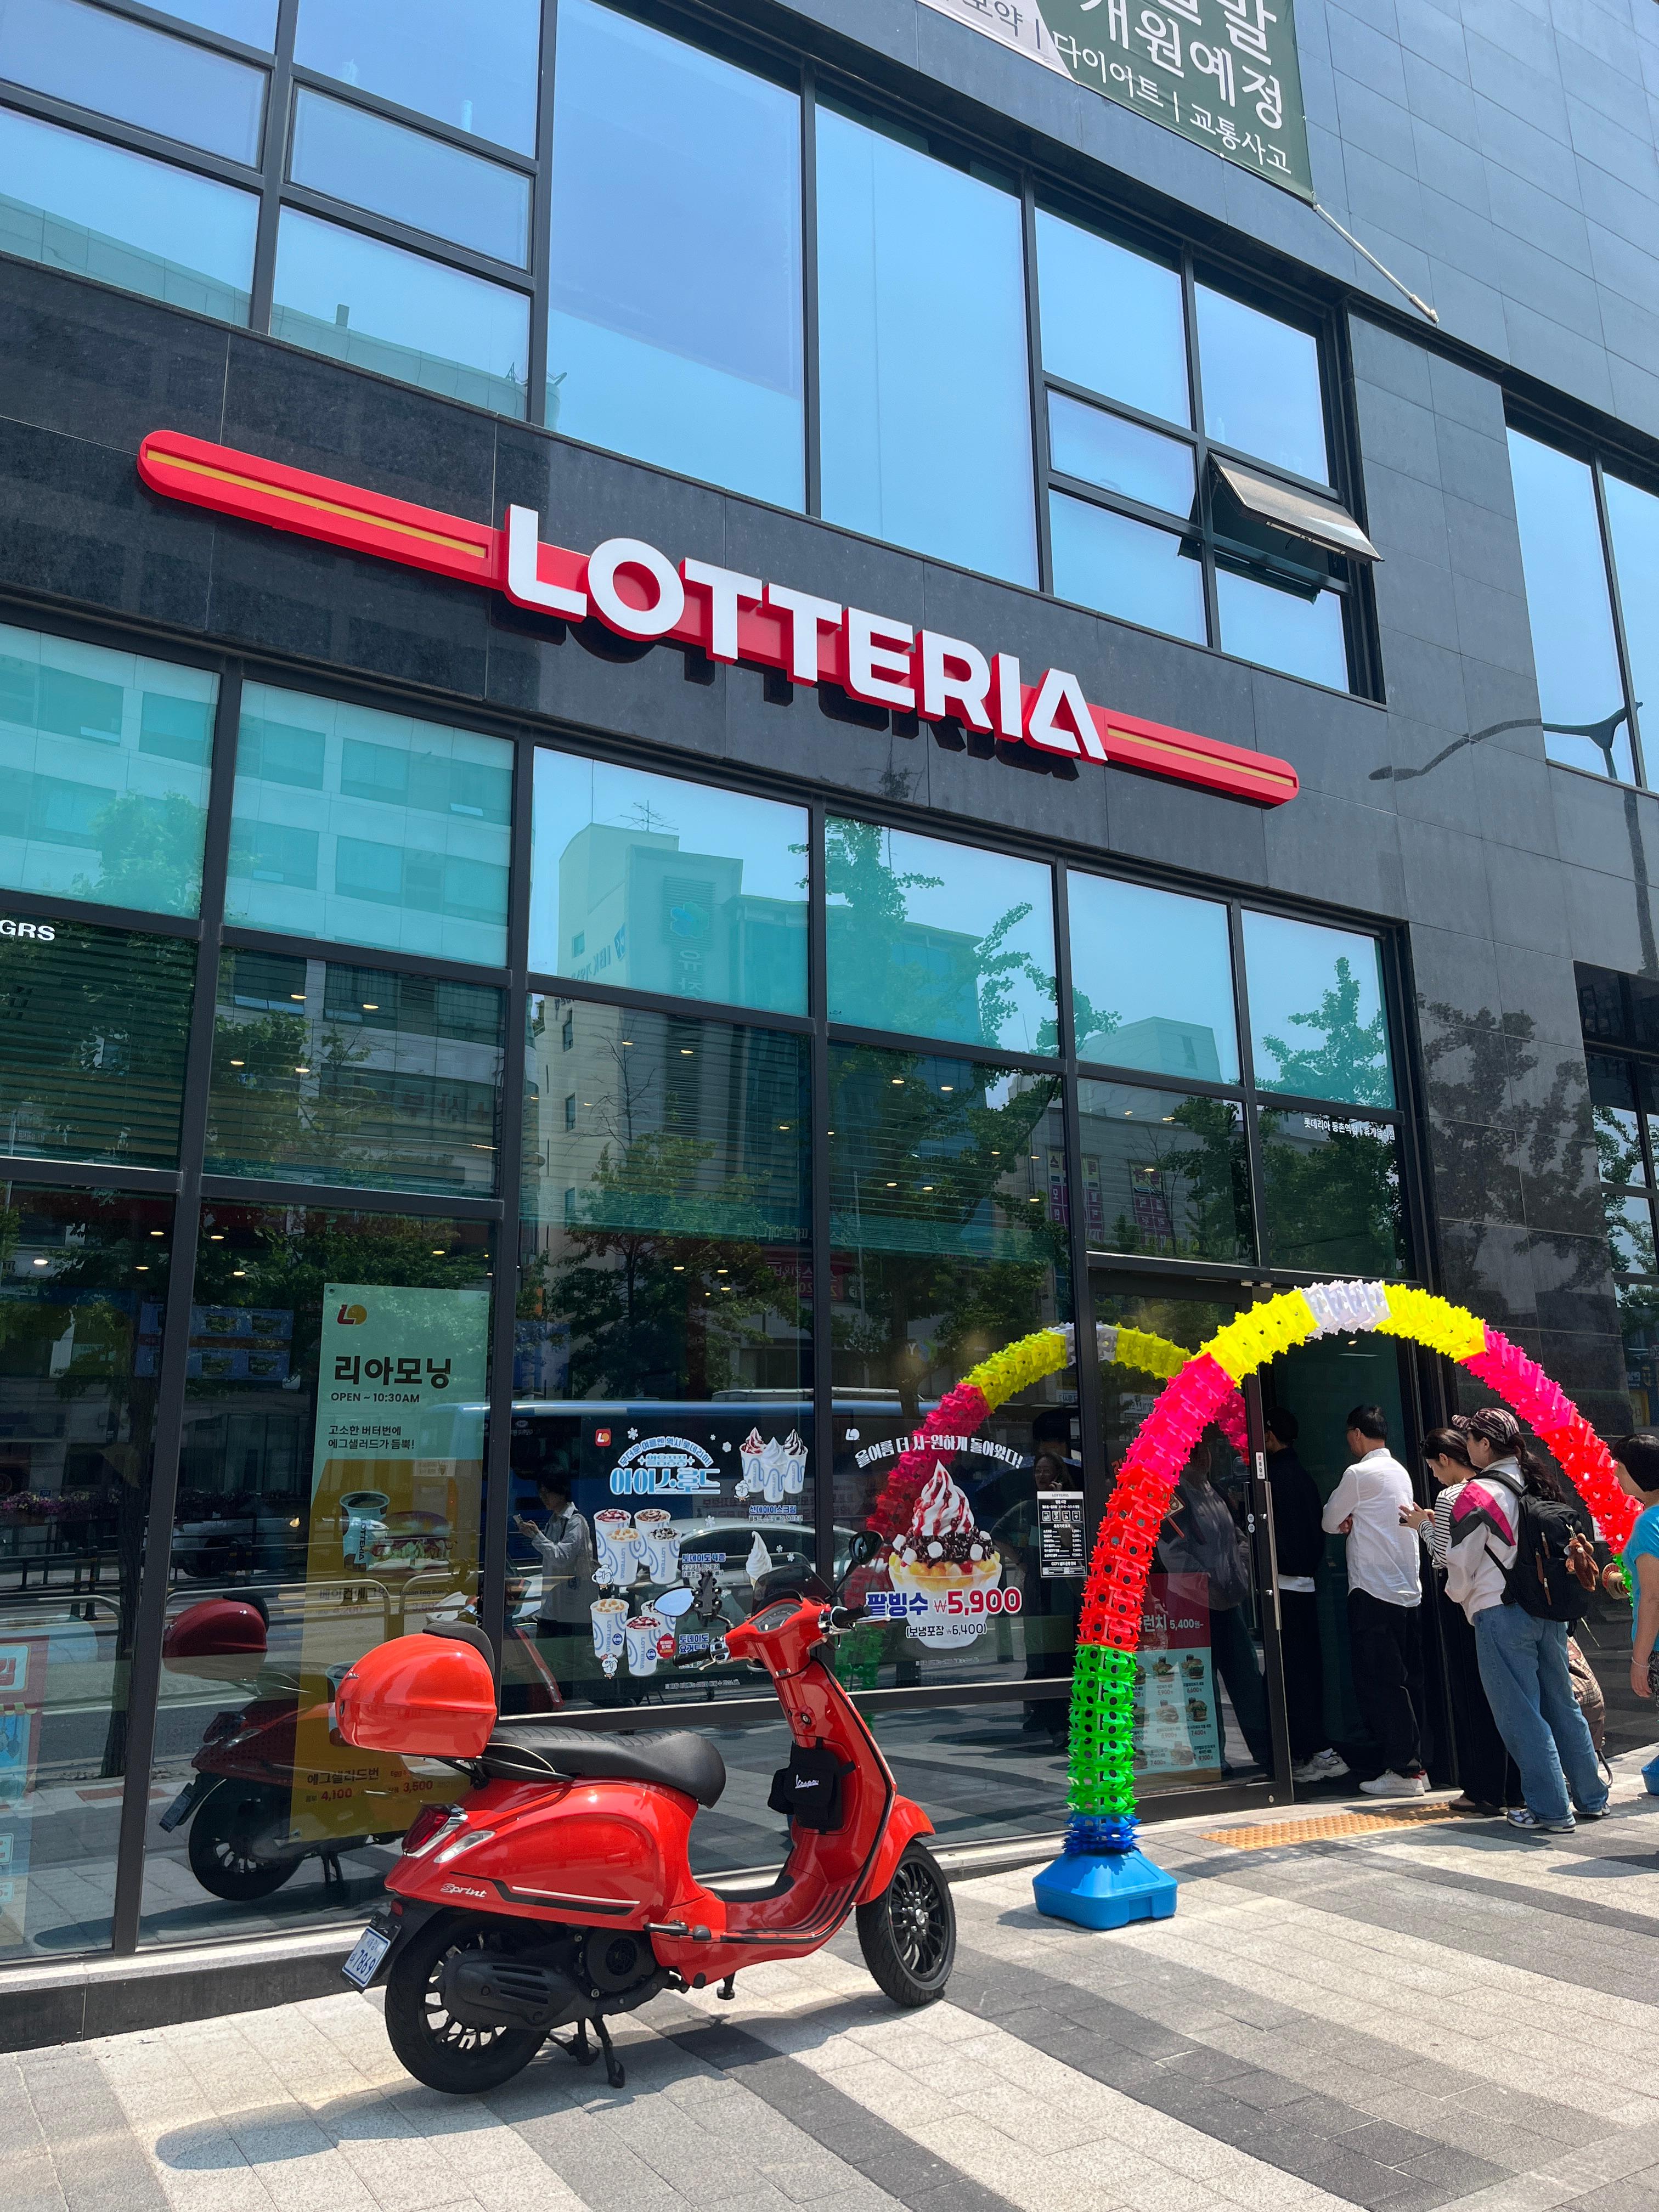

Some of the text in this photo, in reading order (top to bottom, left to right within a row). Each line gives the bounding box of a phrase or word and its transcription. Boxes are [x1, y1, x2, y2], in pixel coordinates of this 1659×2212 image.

[1052, 31, 1164, 108] 다이어트
[1189, 103, 1291, 174] 교통사고
[506, 504, 1107, 765] LOTTERIA
[0, 919, 55, 941] GRS
[1304, 1118, 1331, 1131] 롯데리아
[1331, 1121, 1359, 1136] 등촌역점
[335, 1356, 452, 1389] 리아모닝
[331, 1392, 360, 1402] OPEN
[373, 1393, 420, 1403] 10:30AM
[329, 1425, 402, 1436] 고소한 버터번에
[328, 1439, 415, 1450] 에그샐러드가 듬뿍!
[618, 1443, 642, 1467] 무더운
[640, 1436, 666, 1451] 여름엔
[665, 1436, 682, 1448] 역시
[855, 1440, 895, 1468] 올여름
[895, 1436, 910, 1453] 더
[970, 1437, 1024, 1469] 돌아왔다!
[749, 1505, 797, 1514] 선데아이스크림
[682, 1553, 711, 1562] 토네이도
[867, 1592, 928, 1616] 팥빙수
[1140, 1614, 1167, 1633] 런치
[679, 1633, 709, 1644] 토네이도
[403, 1780, 433, 1793] 3,500
[795, 1774, 819, 1788] Vespa
[321, 1788, 352, 1802] 4,100
[440, 1883, 487, 1898] Sprint
[353, 1949, 376, 1977] 7869
